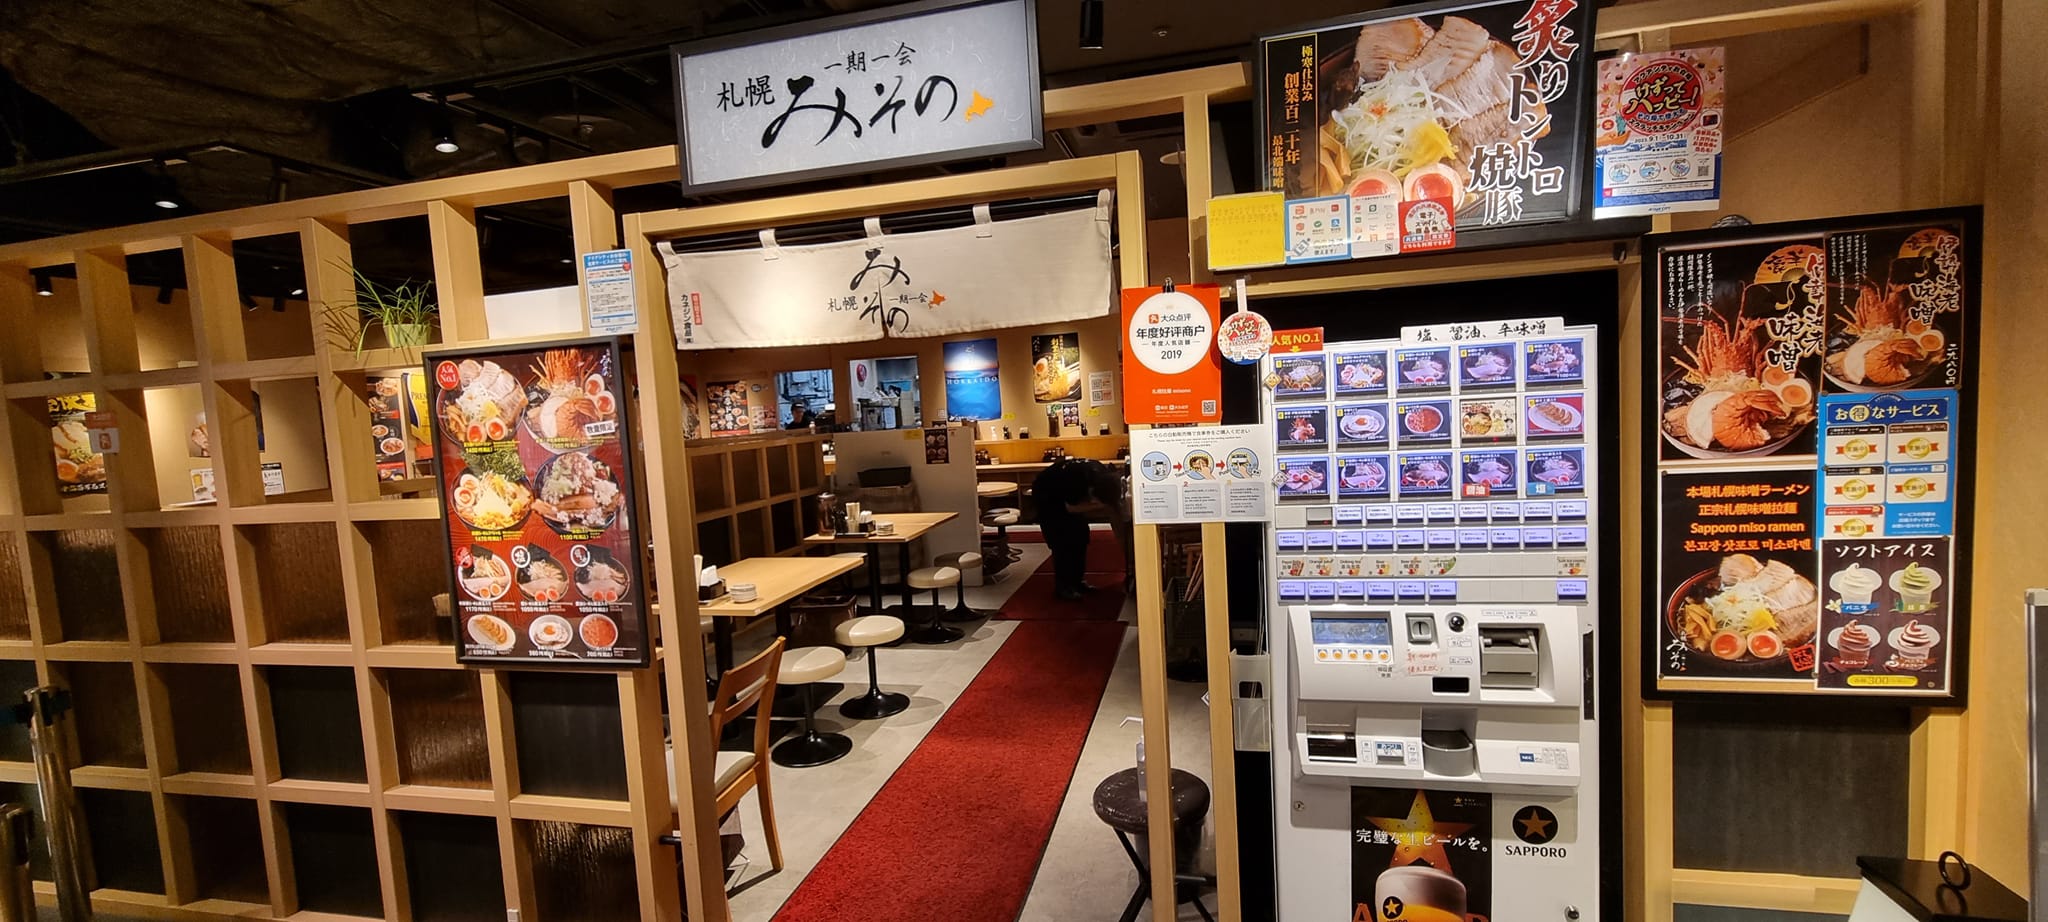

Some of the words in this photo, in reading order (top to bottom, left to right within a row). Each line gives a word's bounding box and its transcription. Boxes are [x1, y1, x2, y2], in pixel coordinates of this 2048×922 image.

[823, 42, 916, 74] 一期一会
[716, 75, 775, 111] 札幌
[1636, 75, 1687, 99] けずって
[762, 75, 958, 149] みその
[1284, 72, 1301, 166] 創業百二十年
[1466, 143, 1525, 227] 焼豚
[827, 296, 859, 312] 札幌
[888, 292, 929, 304] 一期一会
[1161, 313, 1192, 326] 大众点评
[1136, 325, 1206, 340] 年度好评商户
[1767, 312, 1804, 372] 味噌
[1161, 350, 1184, 360] 2019
[947, 376, 999, 386] HOKKAIDO
[1836, 404, 1940, 422] お得なサービス
[1686, 484, 1810, 498] 本場札幌味噌ラーメン
[1690, 523, 1738, 536] Sapporo
[1739, 522, 1766, 533] miso
[1768, 522, 1805, 533] ramen
[1762, 539, 1812, 552] 미소라멘
[1835, 543, 1935, 559] ソフトアイス
[1356, 828, 1488, 853] 完璧な生ビールを。
[1505, 845, 1567, 859] SAPPORO
